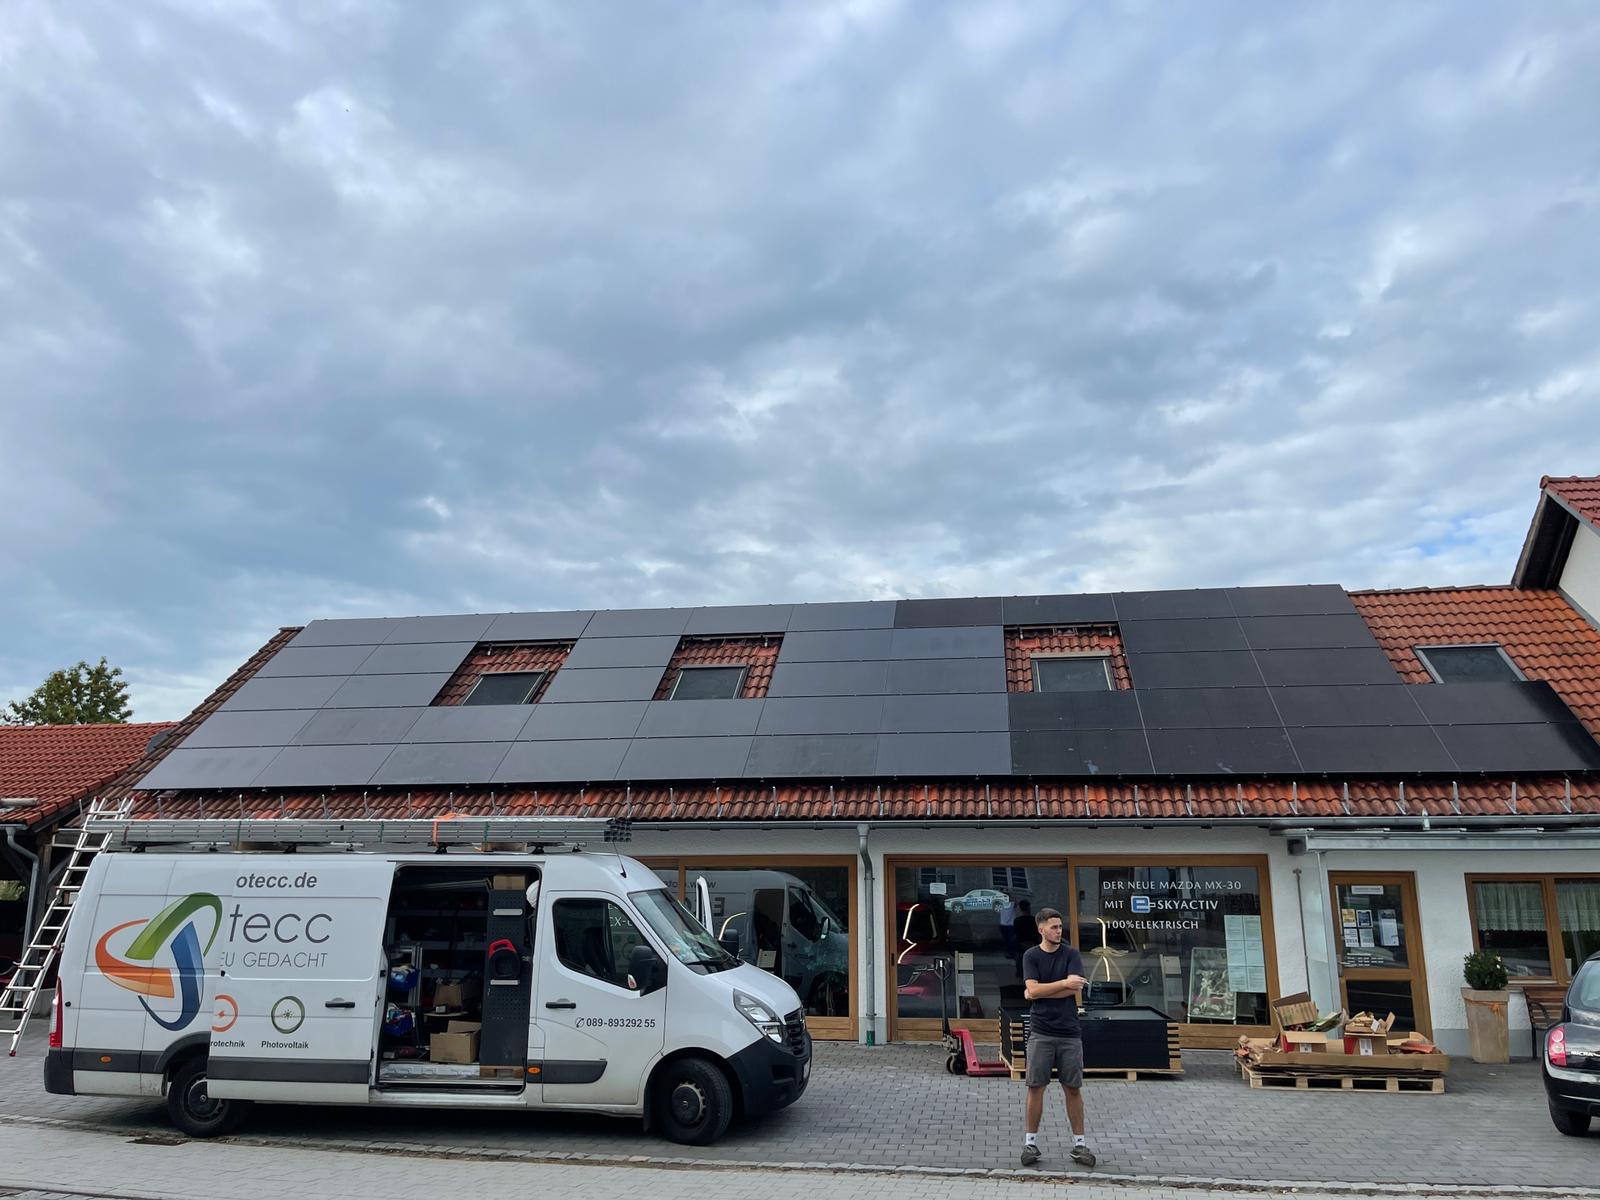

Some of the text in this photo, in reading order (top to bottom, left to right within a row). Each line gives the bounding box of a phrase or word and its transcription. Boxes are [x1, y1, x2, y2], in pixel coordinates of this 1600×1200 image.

[236, 872, 318, 889] otecc.de
[1103, 881, 1242, 890] DER NEUE MAZDA MX-30
[1104, 900, 1125, 909] MIT
[229, 904, 333, 944] tecc
[243, 952, 328, 968] GEDACHT
[261, 1040, 309, 1049] Photovoltaik
